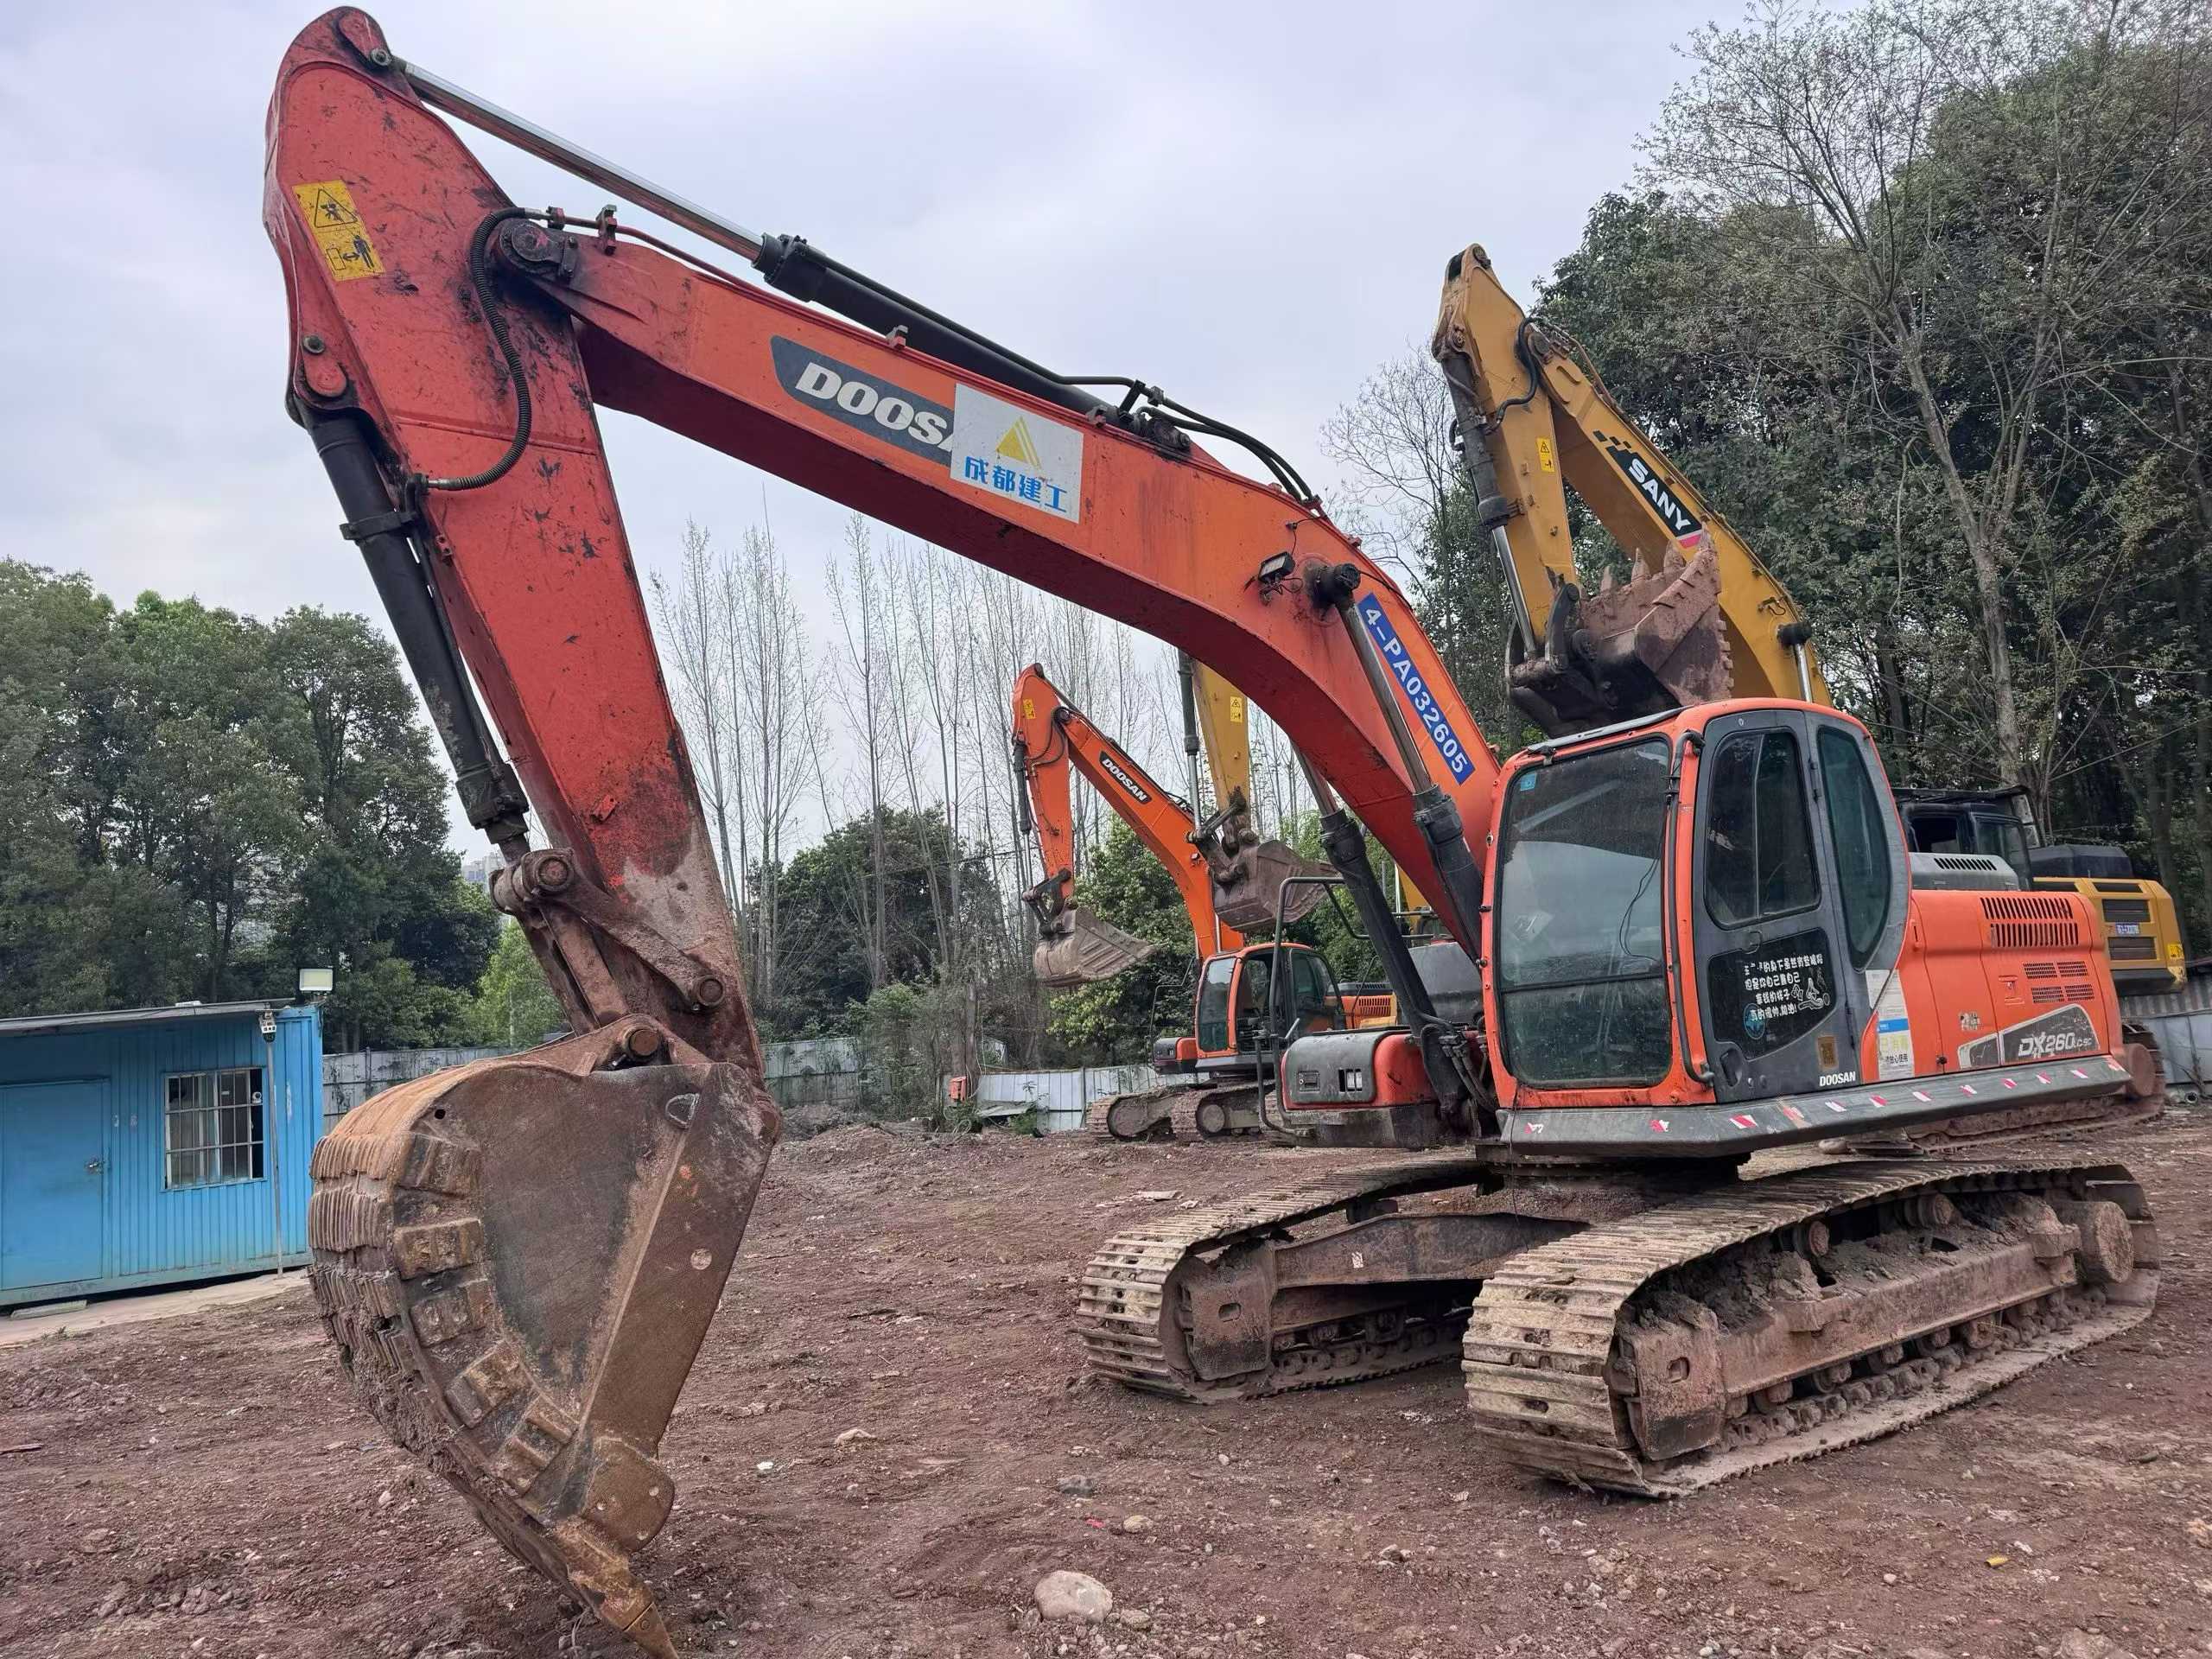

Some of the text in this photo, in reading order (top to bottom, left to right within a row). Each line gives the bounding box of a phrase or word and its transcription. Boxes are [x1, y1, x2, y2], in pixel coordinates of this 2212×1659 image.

[964, 455, 1068, 513] 成都建工
[1629, 458, 1692, 531] SANY
[1365, 608, 1468, 773] 4-PA032605
[1102, 758, 1148, 801] DOOSAN
[1819, 1071, 1856, 1087] DOOSAN
